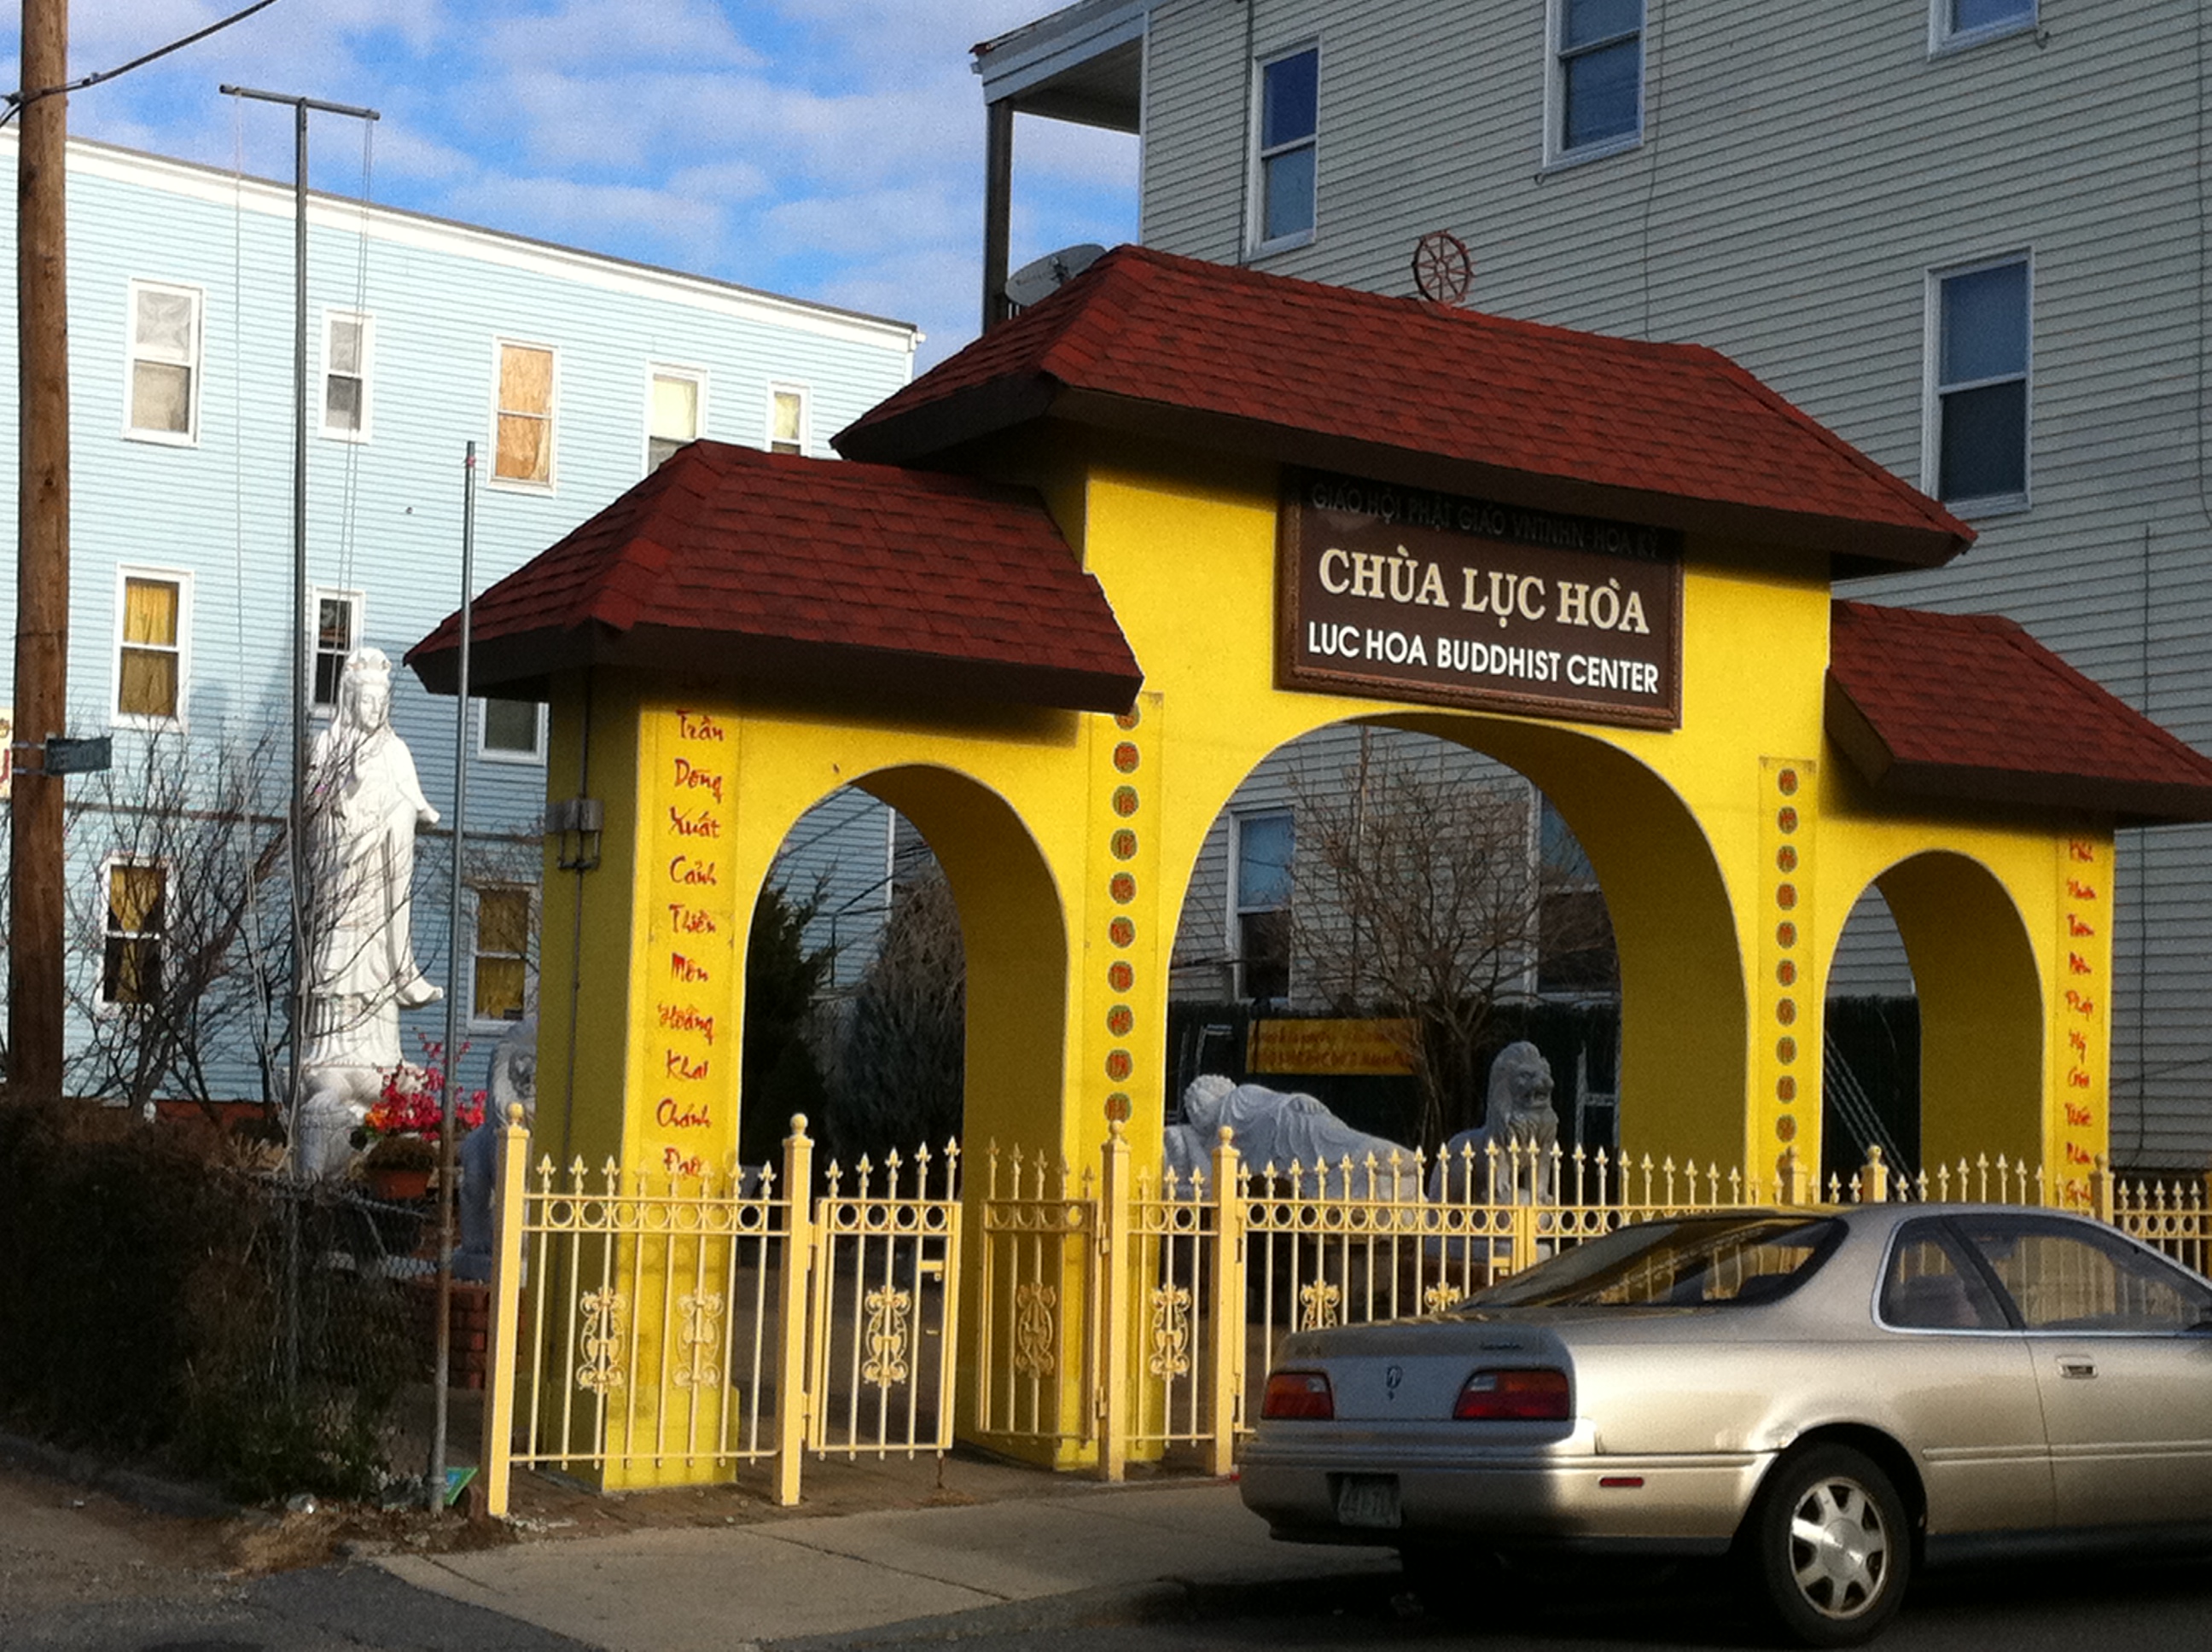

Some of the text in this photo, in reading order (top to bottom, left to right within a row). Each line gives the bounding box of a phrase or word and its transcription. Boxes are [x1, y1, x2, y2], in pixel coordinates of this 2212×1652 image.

[1312, 480, 1363, 514] GIÁO
[1408, 493, 1453, 532] PHẬT
[1458, 502, 1506, 536] GIÁO
[1318, 544, 1650, 635] CHÙA LỤC HÒA
[1309, 621, 1659, 695] LUC HOA BUDDHIST CENTER
[668, 806, 720, 838] Xuất
[669, 854, 717, 886] Cảnh
[672, 951, 708, 982] Môn
[656, 1098, 712, 1128] Chánh
